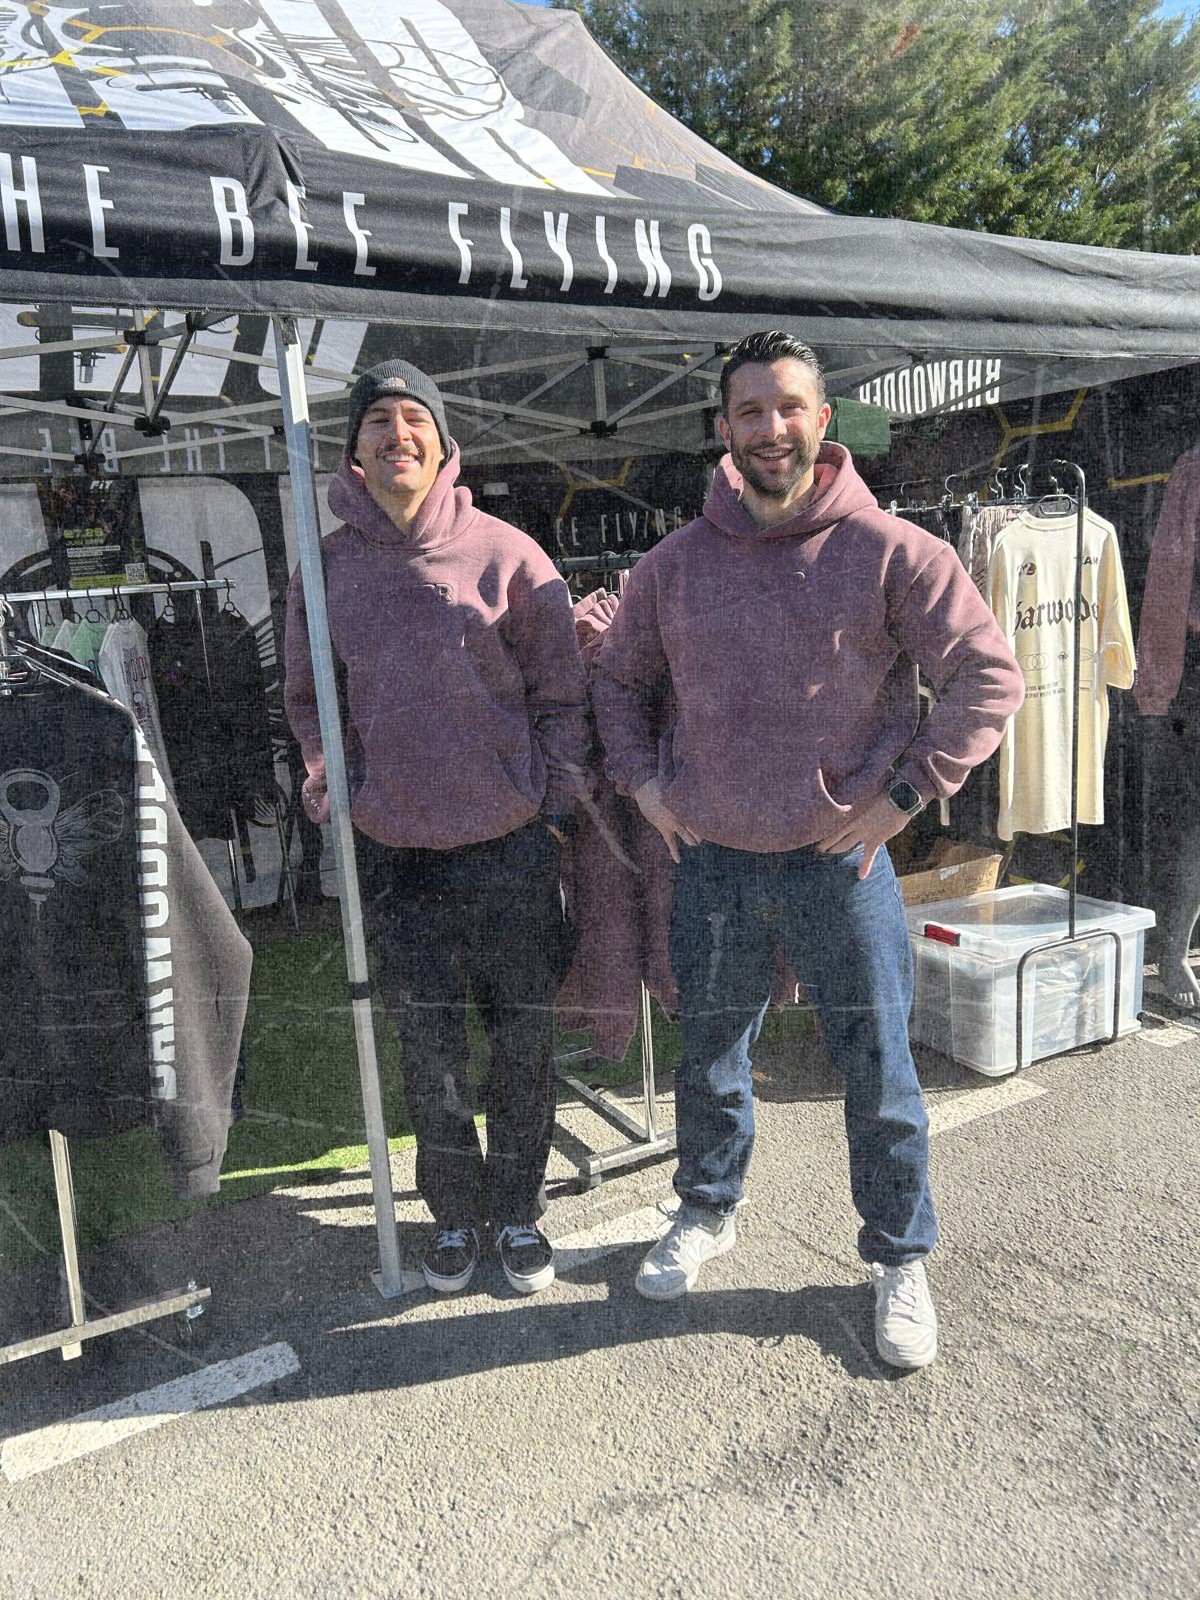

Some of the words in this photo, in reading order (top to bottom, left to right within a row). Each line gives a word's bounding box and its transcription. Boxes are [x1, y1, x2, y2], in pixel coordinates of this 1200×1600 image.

[209, 176, 377, 276] BEE
[448, 201, 722, 301] FLYING
[600, 506, 682, 543] FLYING
